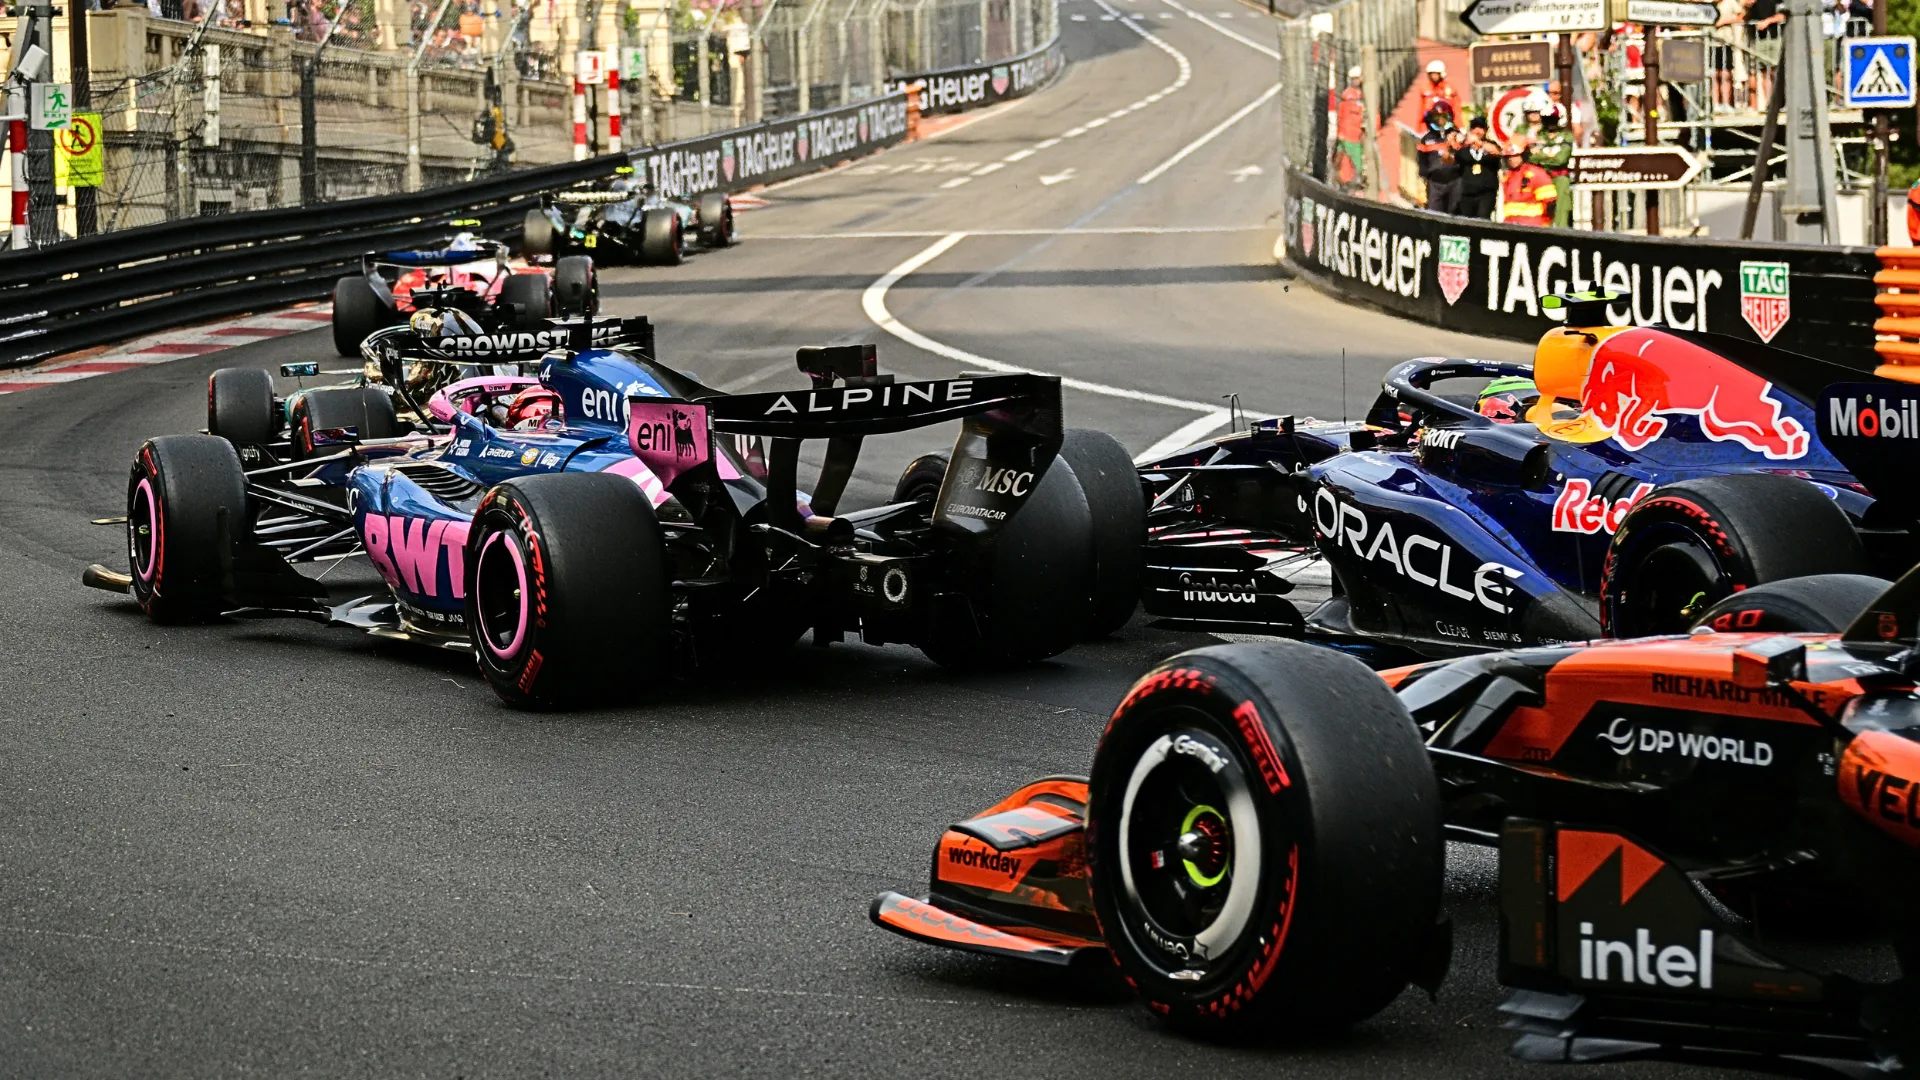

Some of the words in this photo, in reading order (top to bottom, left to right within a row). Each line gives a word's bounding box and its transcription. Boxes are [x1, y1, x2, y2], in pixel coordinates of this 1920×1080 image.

[1477, 4, 1511, 16] Centre
[1481, 65, 1542, 78] D'OSTENDE
[1491, 50, 1532, 63] AVENUE
[1743, 267, 1785, 293] TAG
[1743, 298, 1787, 336] HEUER
[439, 327, 622, 357] CROWDSTKE
[582, 381, 624, 422] eni
[763, 380, 974, 416] ALPINE
[637, 412, 671, 452] eni
[1829, 397, 1919, 439] Mobil
[975, 466, 1034, 497] MSC
[946, 503, 1007, 521] EURODATACAR
[1552, 478, 1656, 535] Red
[364, 512, 473, 599] BWT
[1315, 487, 1525, 615] ORACLE
[1179, 572, 1258, 603] indeed
[1436, 620, 1471, 640] CLEAR
[1652, 673, 1750, 703] RICHARD
[1173, 734, 1230, 774] Gemini
[1639, 728, 1675, 753] DP
[1677, 732, 1773, 766] WORLD
[949, 847, 1021, 879] workday
[1580, 921, 1714, 989] intel
